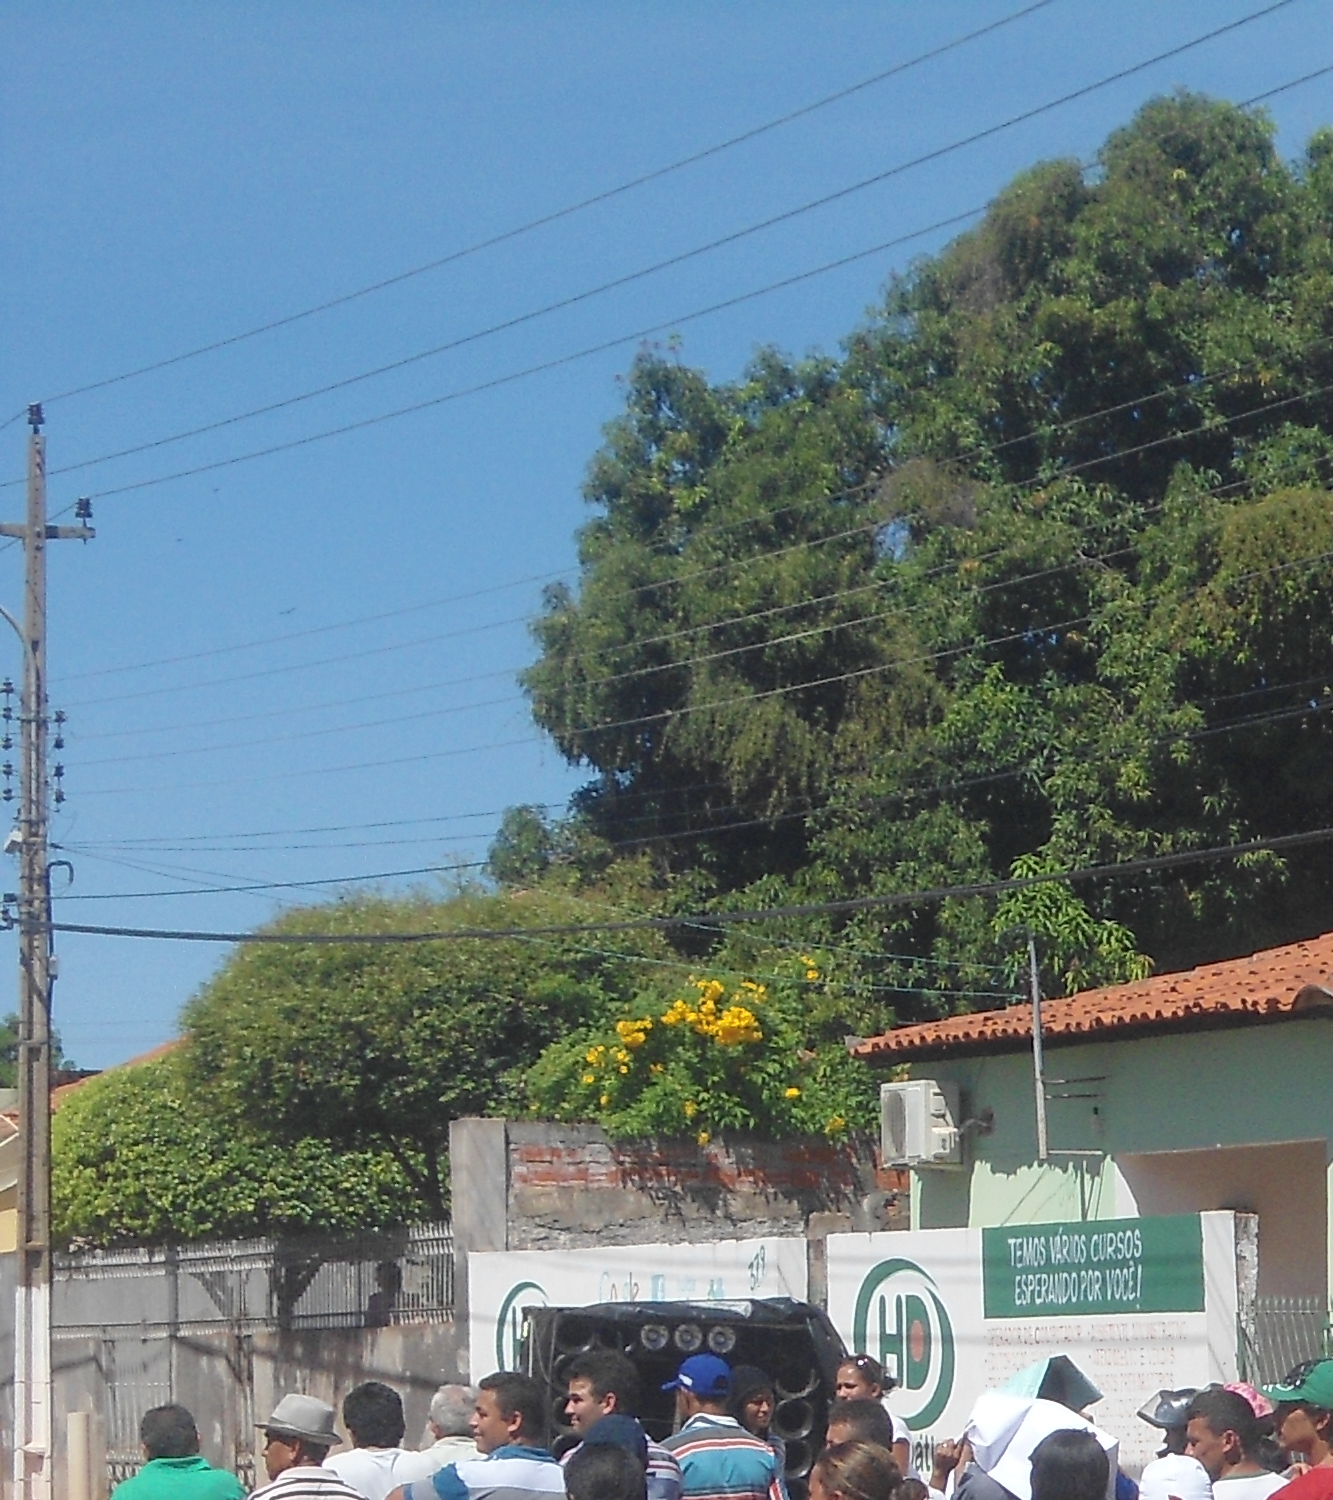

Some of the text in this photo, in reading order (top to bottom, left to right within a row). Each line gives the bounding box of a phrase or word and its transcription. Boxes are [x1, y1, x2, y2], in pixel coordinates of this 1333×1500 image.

[1008, 1226, 1142, 1268] TEMOS VÁRIOS CURSOS
[1015, 1260, 1142, 1309] ESPERANDO POR VOCÊ!
[879, 1294, 932, 1390] HD
